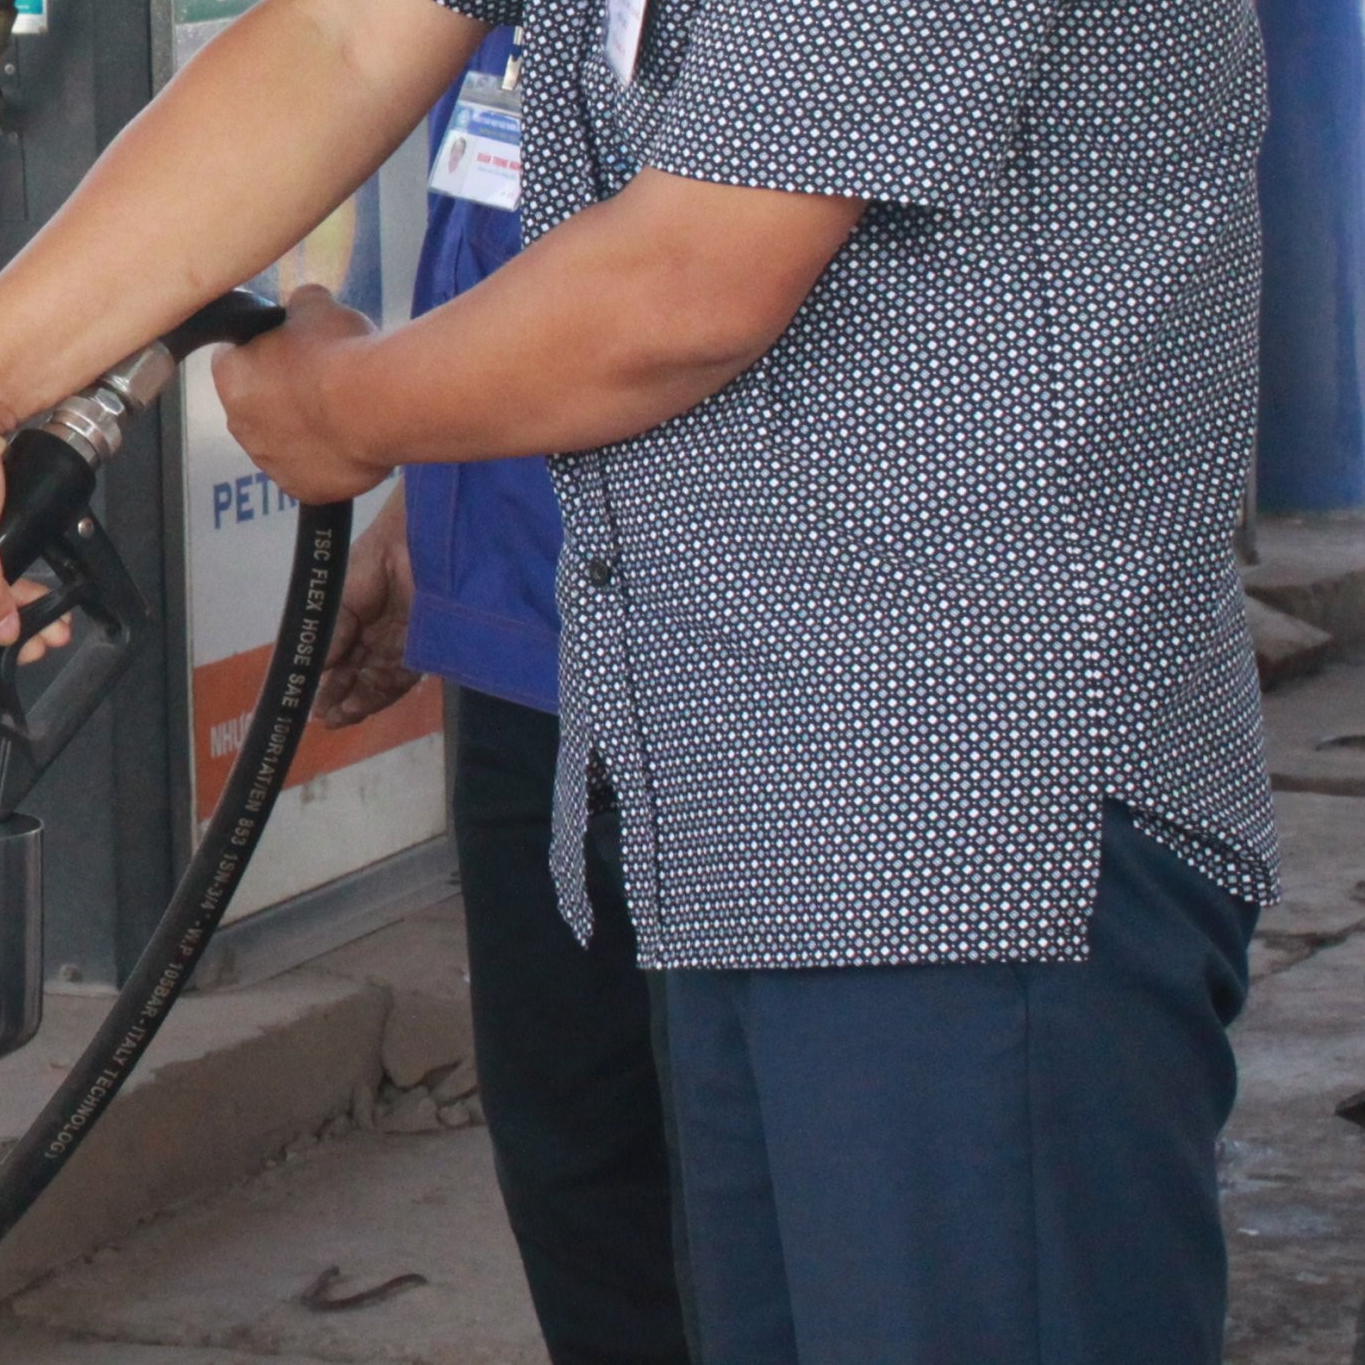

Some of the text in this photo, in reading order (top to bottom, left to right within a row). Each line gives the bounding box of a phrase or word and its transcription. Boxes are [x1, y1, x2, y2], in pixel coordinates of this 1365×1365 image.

[313, 527, 333, 561] TSC
[306, 568, 328, 612] FLEX
[294, 618, 319, 666] HOSE
[282, 672, 306, 708] SAE
